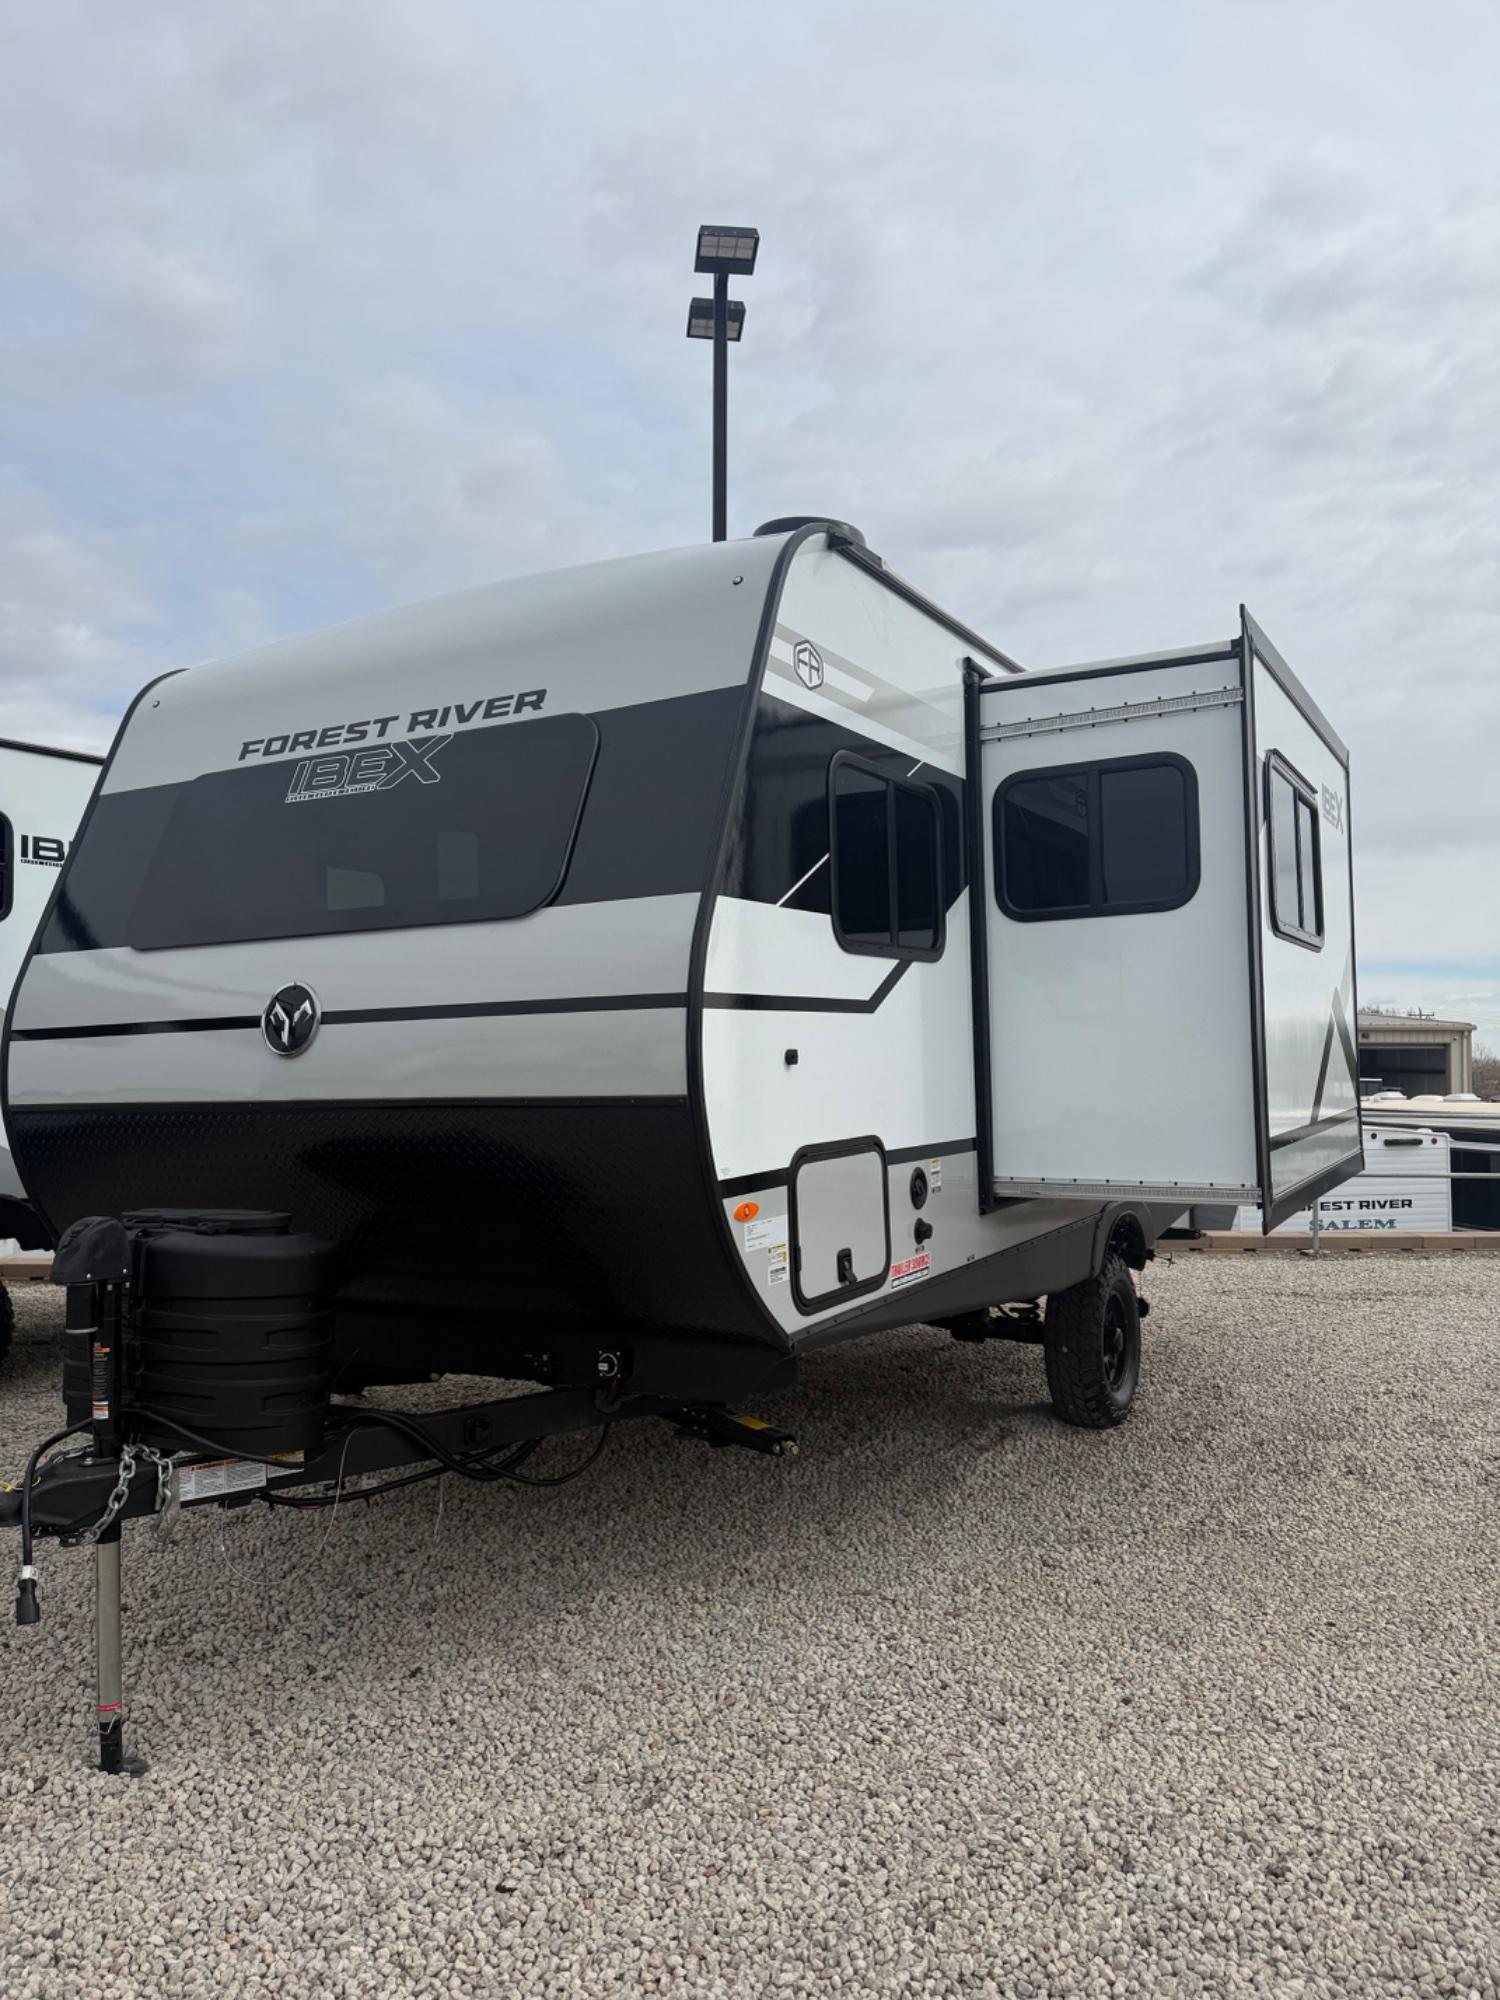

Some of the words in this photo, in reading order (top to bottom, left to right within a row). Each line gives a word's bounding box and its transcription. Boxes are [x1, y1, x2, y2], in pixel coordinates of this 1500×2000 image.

[238, 715, 399, 761] FOREST
[406, 689, 548, 733] RIVER
[286, 732, 455, 796] IBEX
[20, 834, 74, 863] IB
[1358, 1199, 1413, 1211] RIVER
[1309, 1219, 1398, 1232] SALEM
